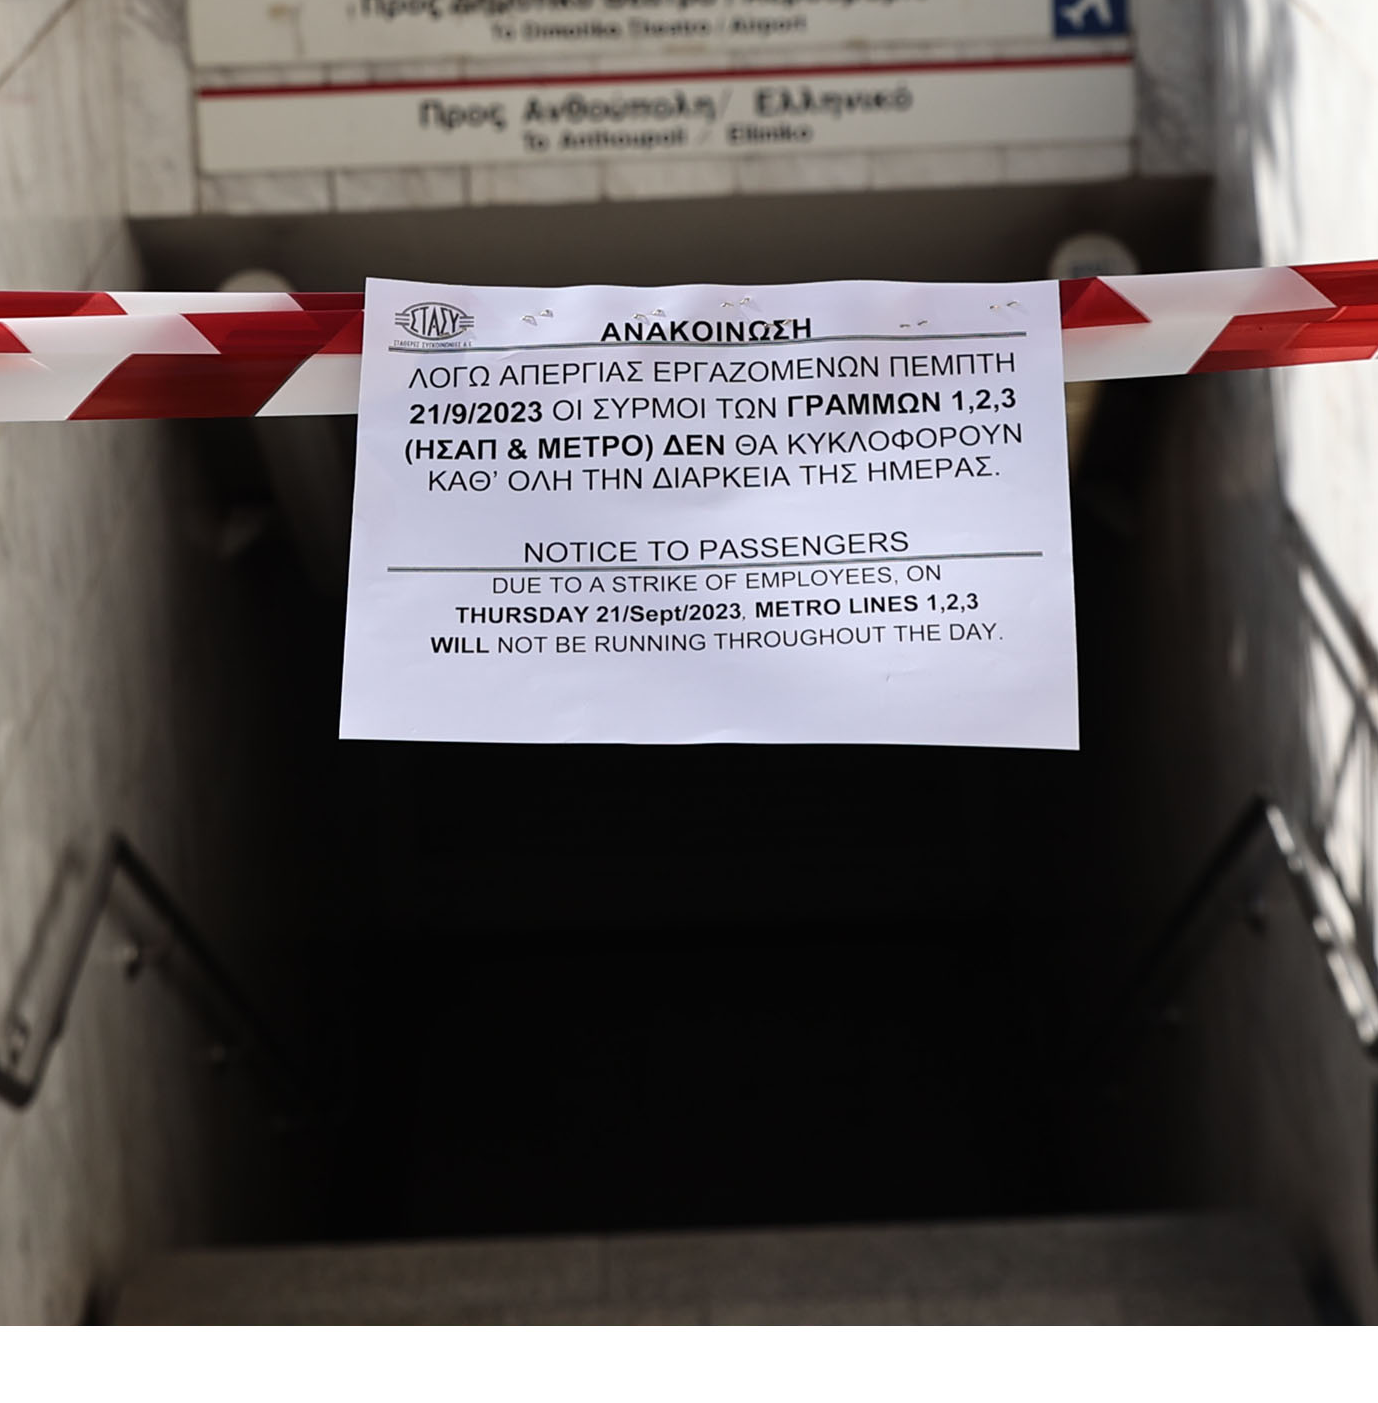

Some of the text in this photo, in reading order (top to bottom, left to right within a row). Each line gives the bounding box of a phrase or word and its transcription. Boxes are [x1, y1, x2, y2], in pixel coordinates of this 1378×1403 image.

[419, 97, 507, 132] Προς
[753, 79, 915, 119] Ελληνικό
[410, 306, 459, 336] ΣΤΑΣΥ
[601, 317, 812, 342] ΑΝΑΚΟΙΝΩΣΗ
[408, 351, 1015, 389] ΛΟΓΩ ΑΠΕΡΓΙΑΣ ΕΡΓΑΖΟΜΕΝΩΝ ΠΕΜΠΤΗ
[409, 387, 1017, 425] 21/9/2023 ΟΙ ΣΥΡΜΟΙ ΤΩΝ ΓΡΑΜΜΩΝ 1,2,3
[404, 422, 1022, 466] (ΗΣΑΠ & ΜΕΤΡΟ) ΔΕΝ ΘΑ ΚΥΚΛΟΦΟΡΟΥΝ
[507, 469, 572, 492] ΟΛΗ
[581, 467, 643, 491] ΤΗΝ
[652, 465, 791, 490] ΔΙΑΡΚΕΙΑ
[798, 462, 858, 486] ΤΗΣ
[868, 455, 1000, 482] ΗΜΕΡΑΣ.
[524, 530, 909, 564] NOTICE TO PASSENGERS
[492, 564, 941, 595] DUE TO A STRIKE OF EMPLOYEES, ON
[454, 592, 979, 627] THURSDAY 21/Sept/2023, METRO LINES 1,2,3
[430, 622, 1003, 654] WILL NOT BE RUNNING THROUGHOUT THE DAY.
